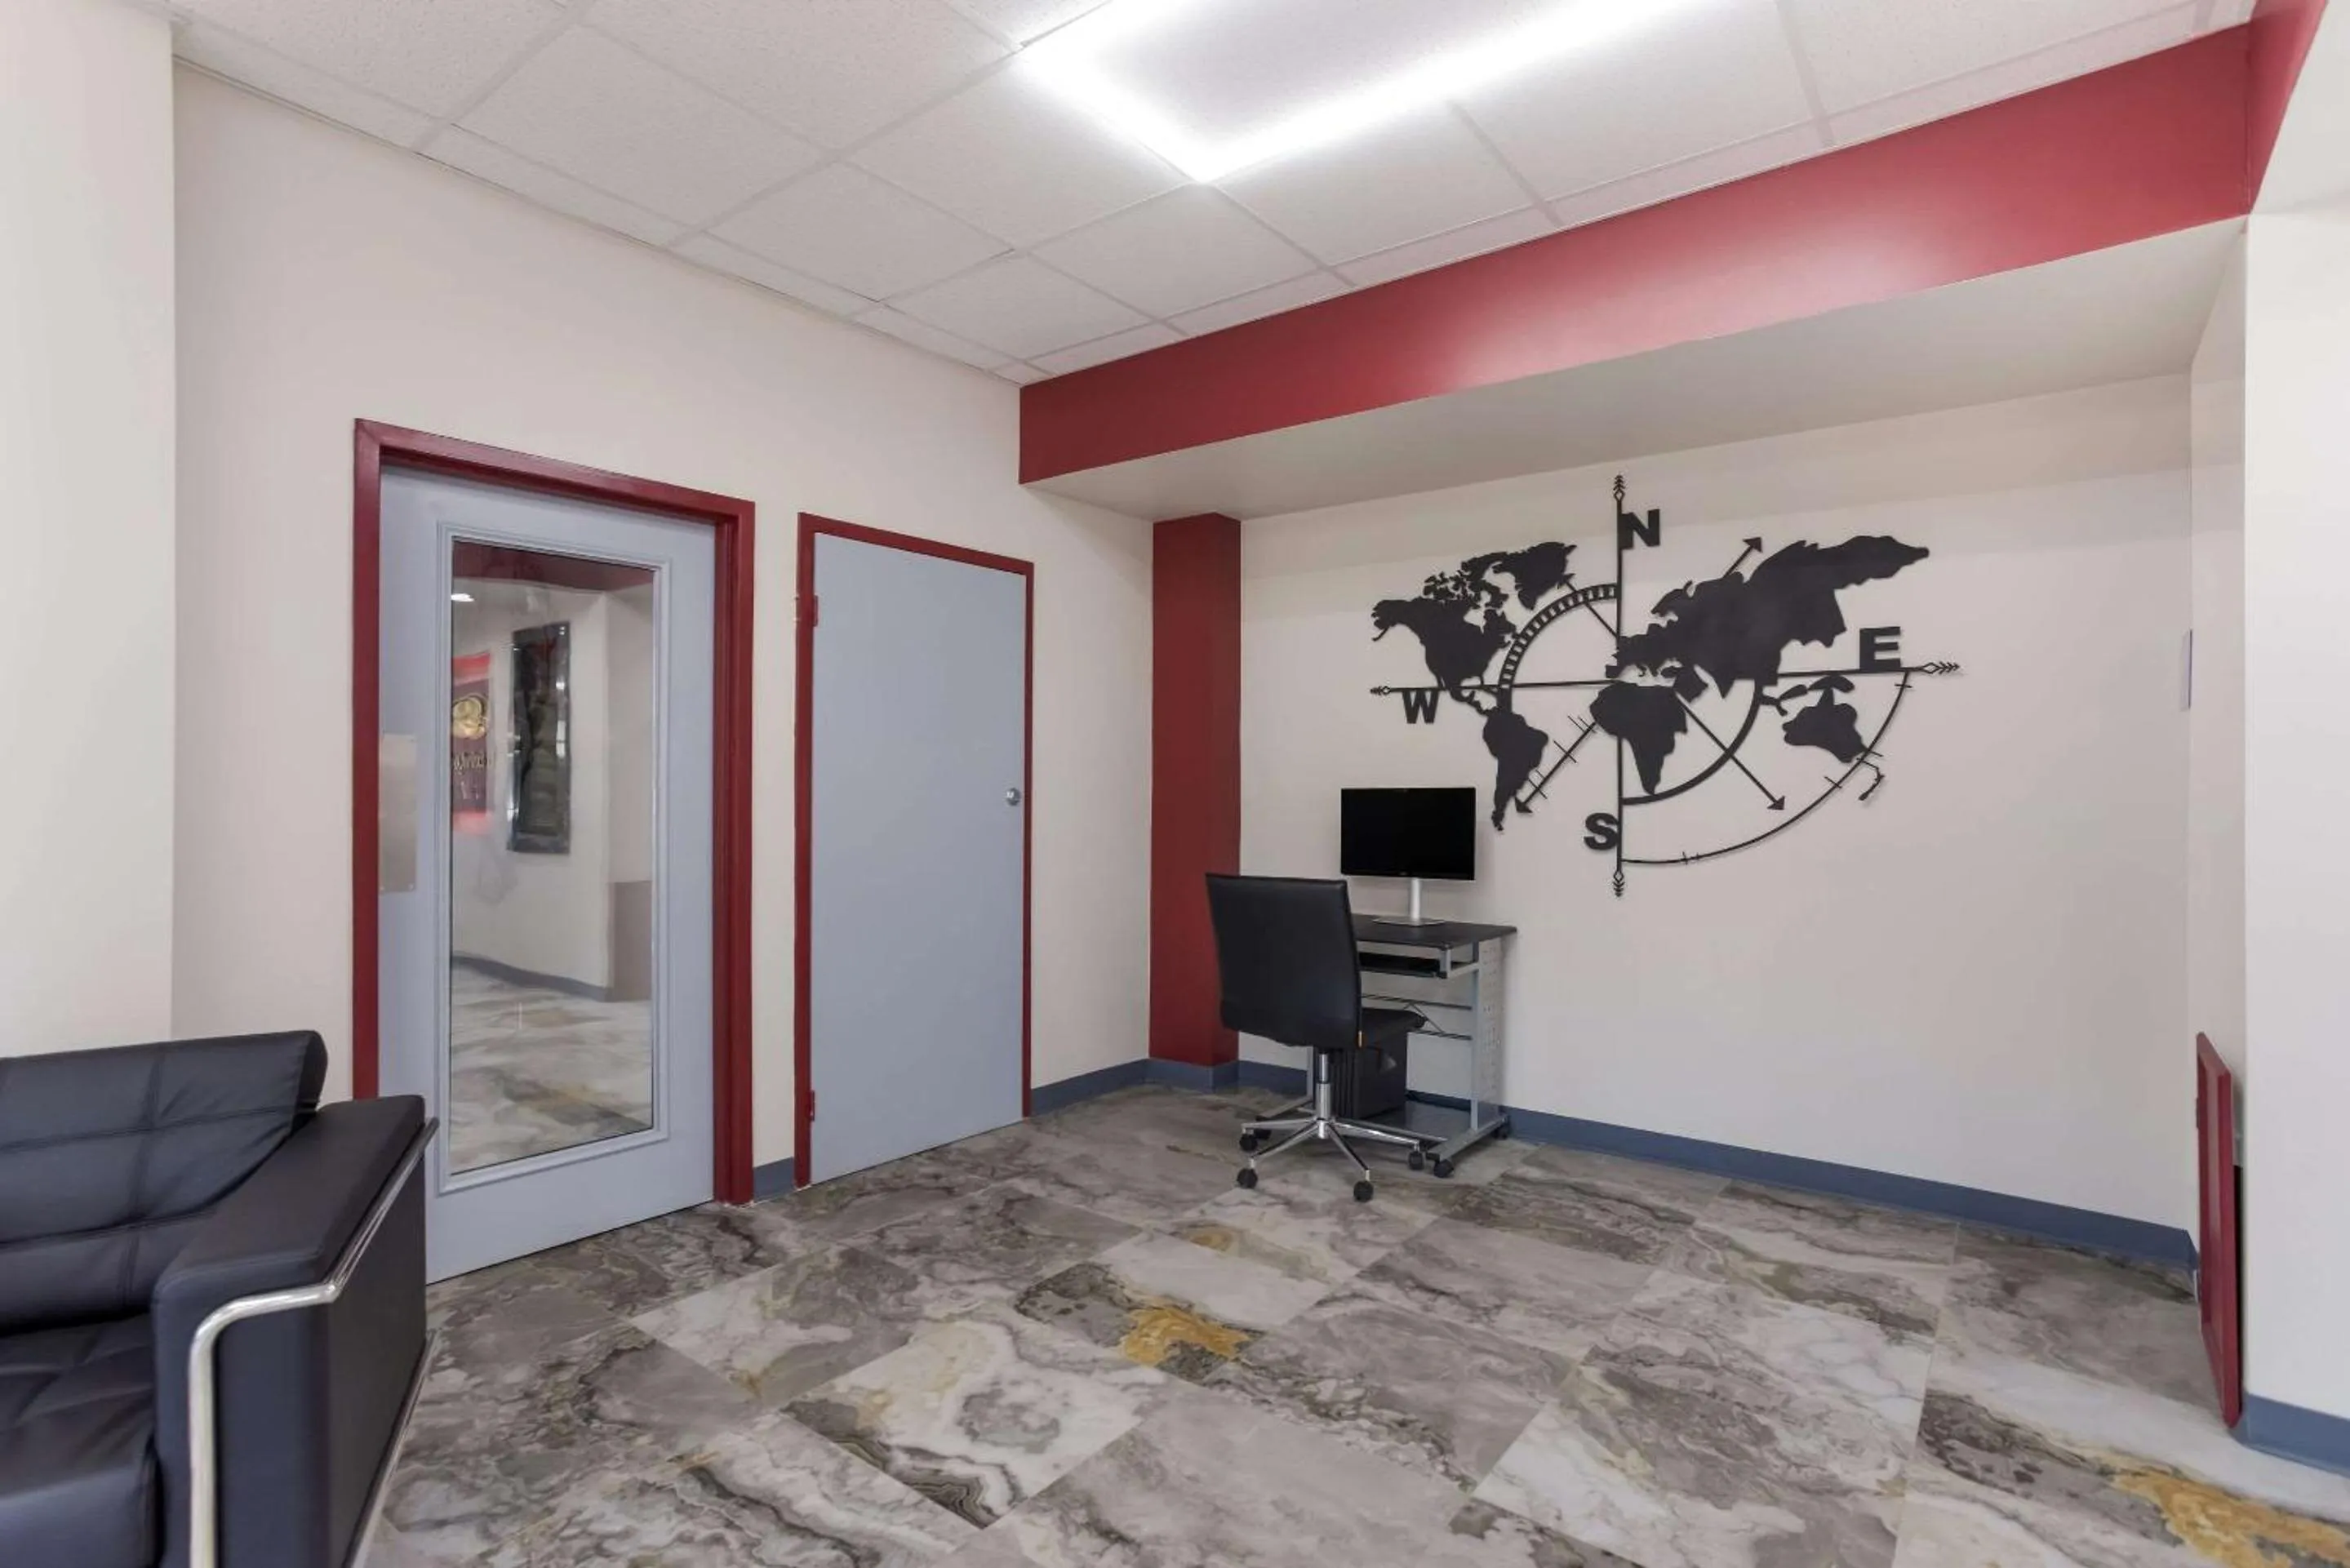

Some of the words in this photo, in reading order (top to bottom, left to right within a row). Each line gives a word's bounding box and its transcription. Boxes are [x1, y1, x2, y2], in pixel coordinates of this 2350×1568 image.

[1619, 509, 1660, 550] N
[1859, 626, 1901, 669] E
[1402, 688, 1440, 724] W
[1583, 813, 1620, 851] S
